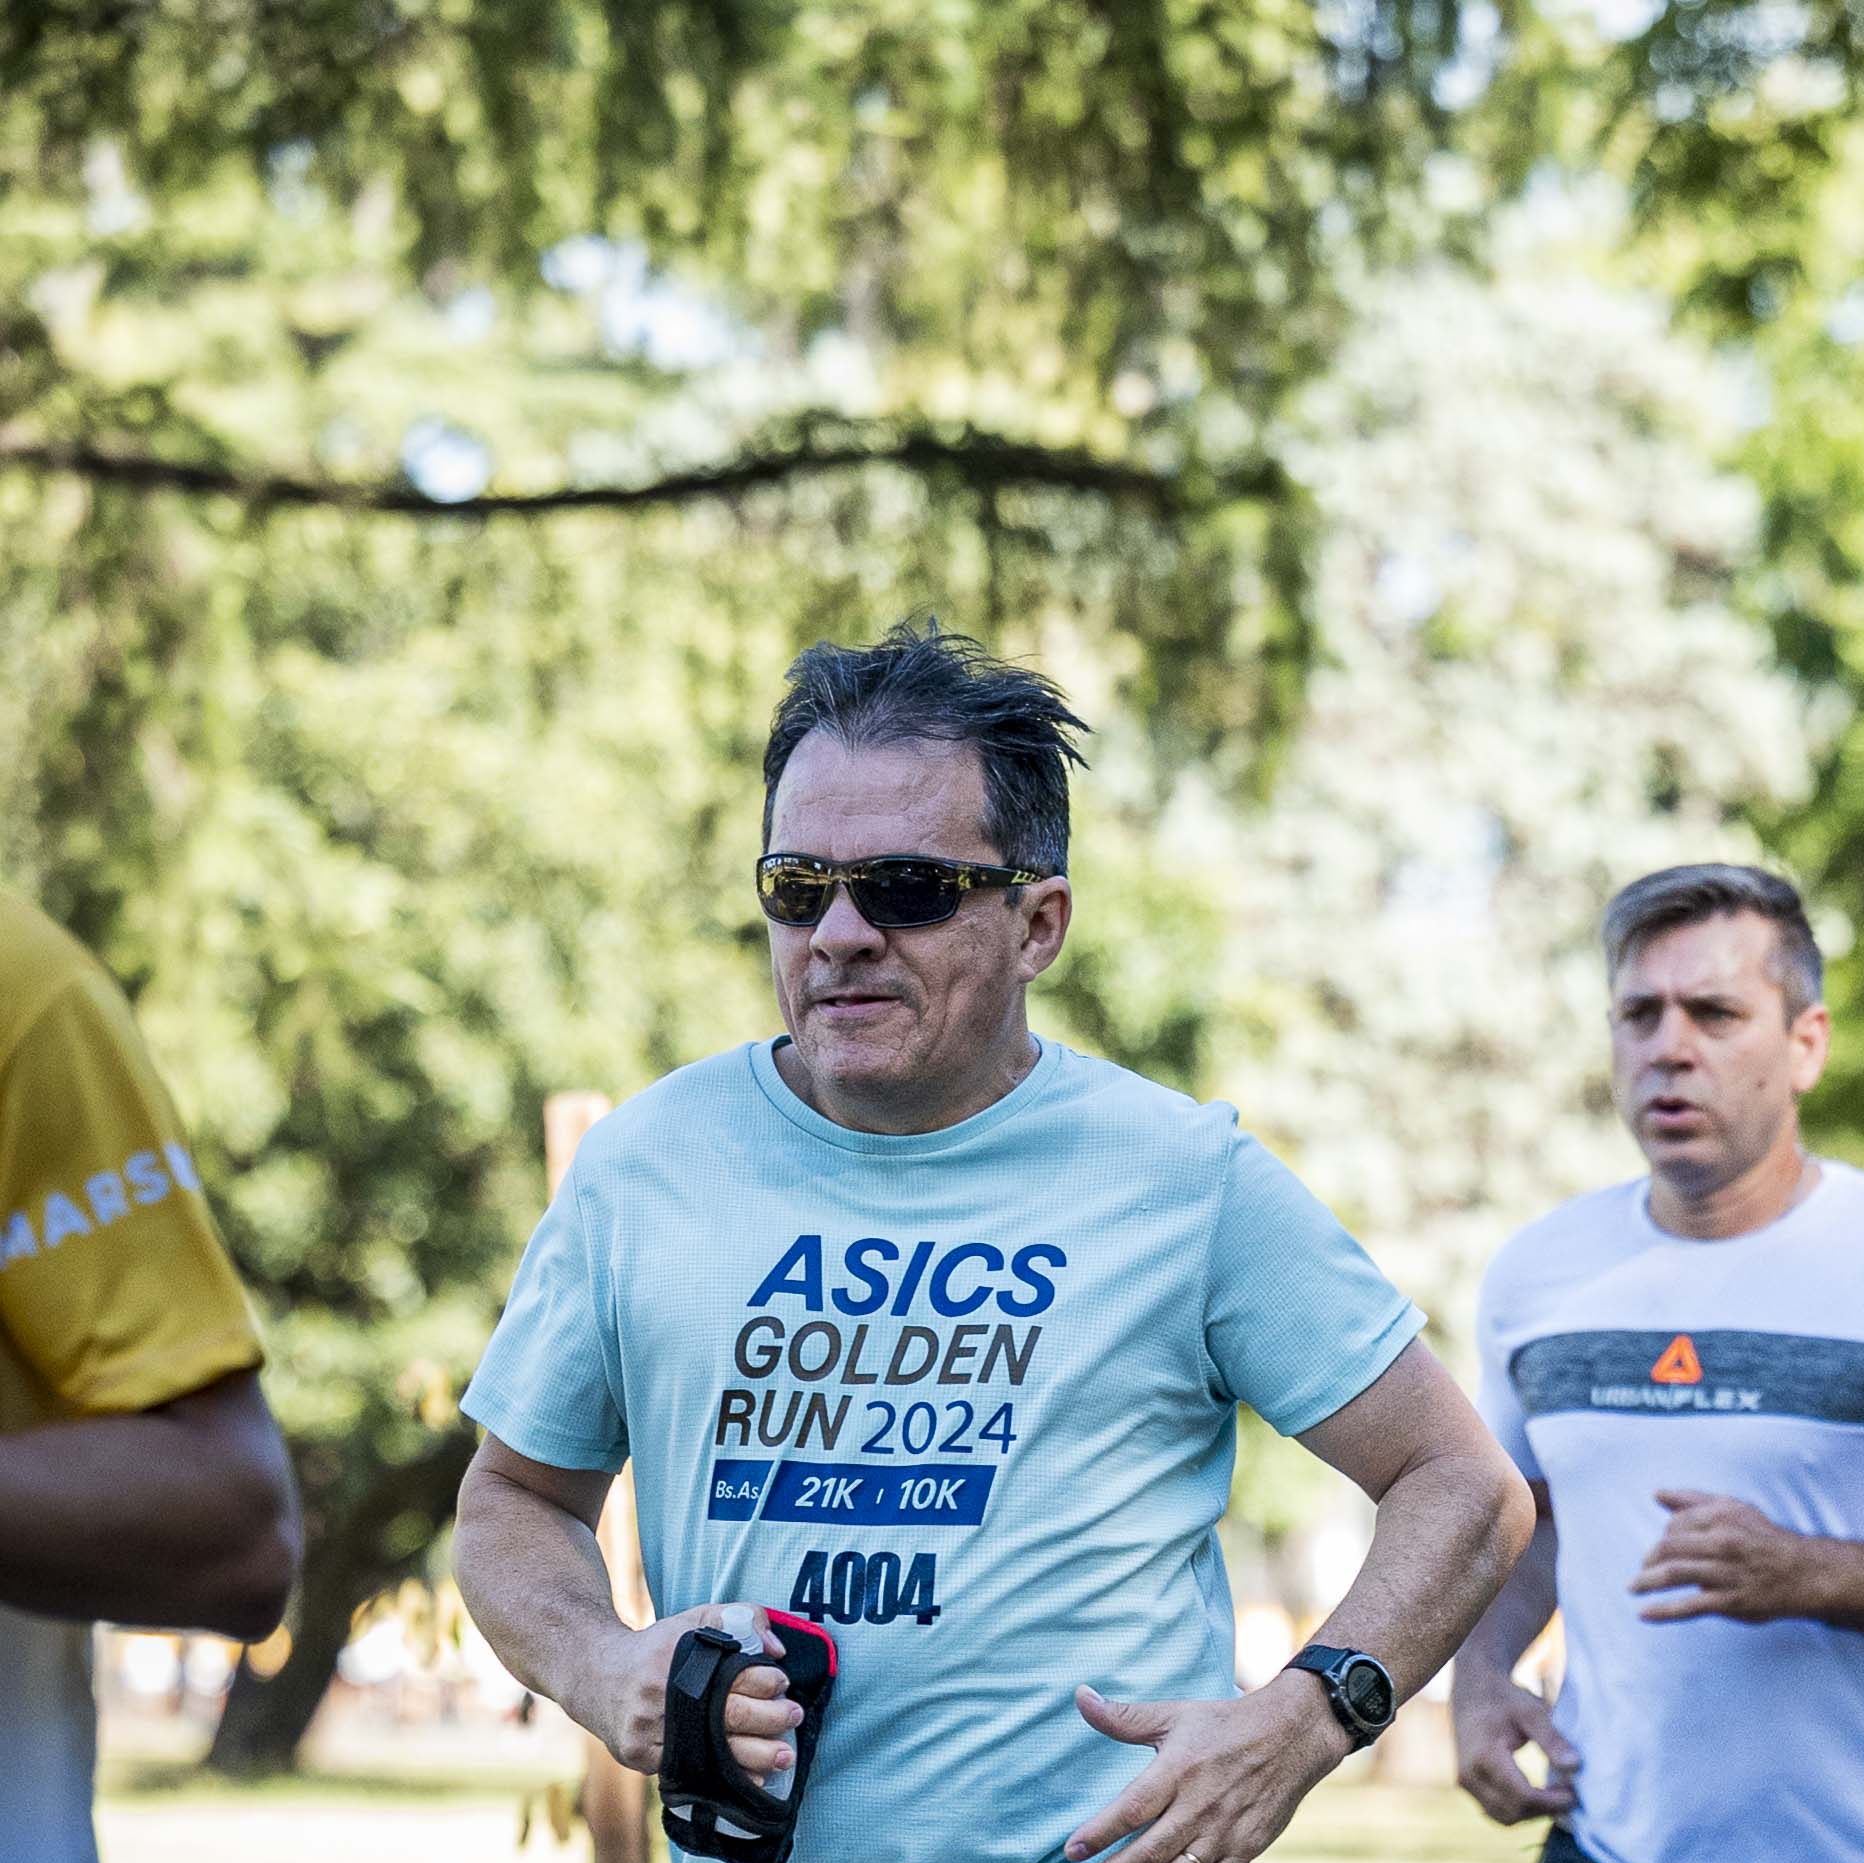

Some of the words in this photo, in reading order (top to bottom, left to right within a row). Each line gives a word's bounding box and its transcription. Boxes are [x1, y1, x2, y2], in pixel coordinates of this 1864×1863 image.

[747, 1235, 1066, 1317] ASICS
[735, 1316, 1042, 1385] GOLDEN
[715, 1389, 853, 1450] RUN
[861, 1400, 1017, 1454] 2024
[794, 1476, 863, 1509] 21K
[899, 1478, 966, 1510] 10K
[789, 1550, 941, 1626] 4004
